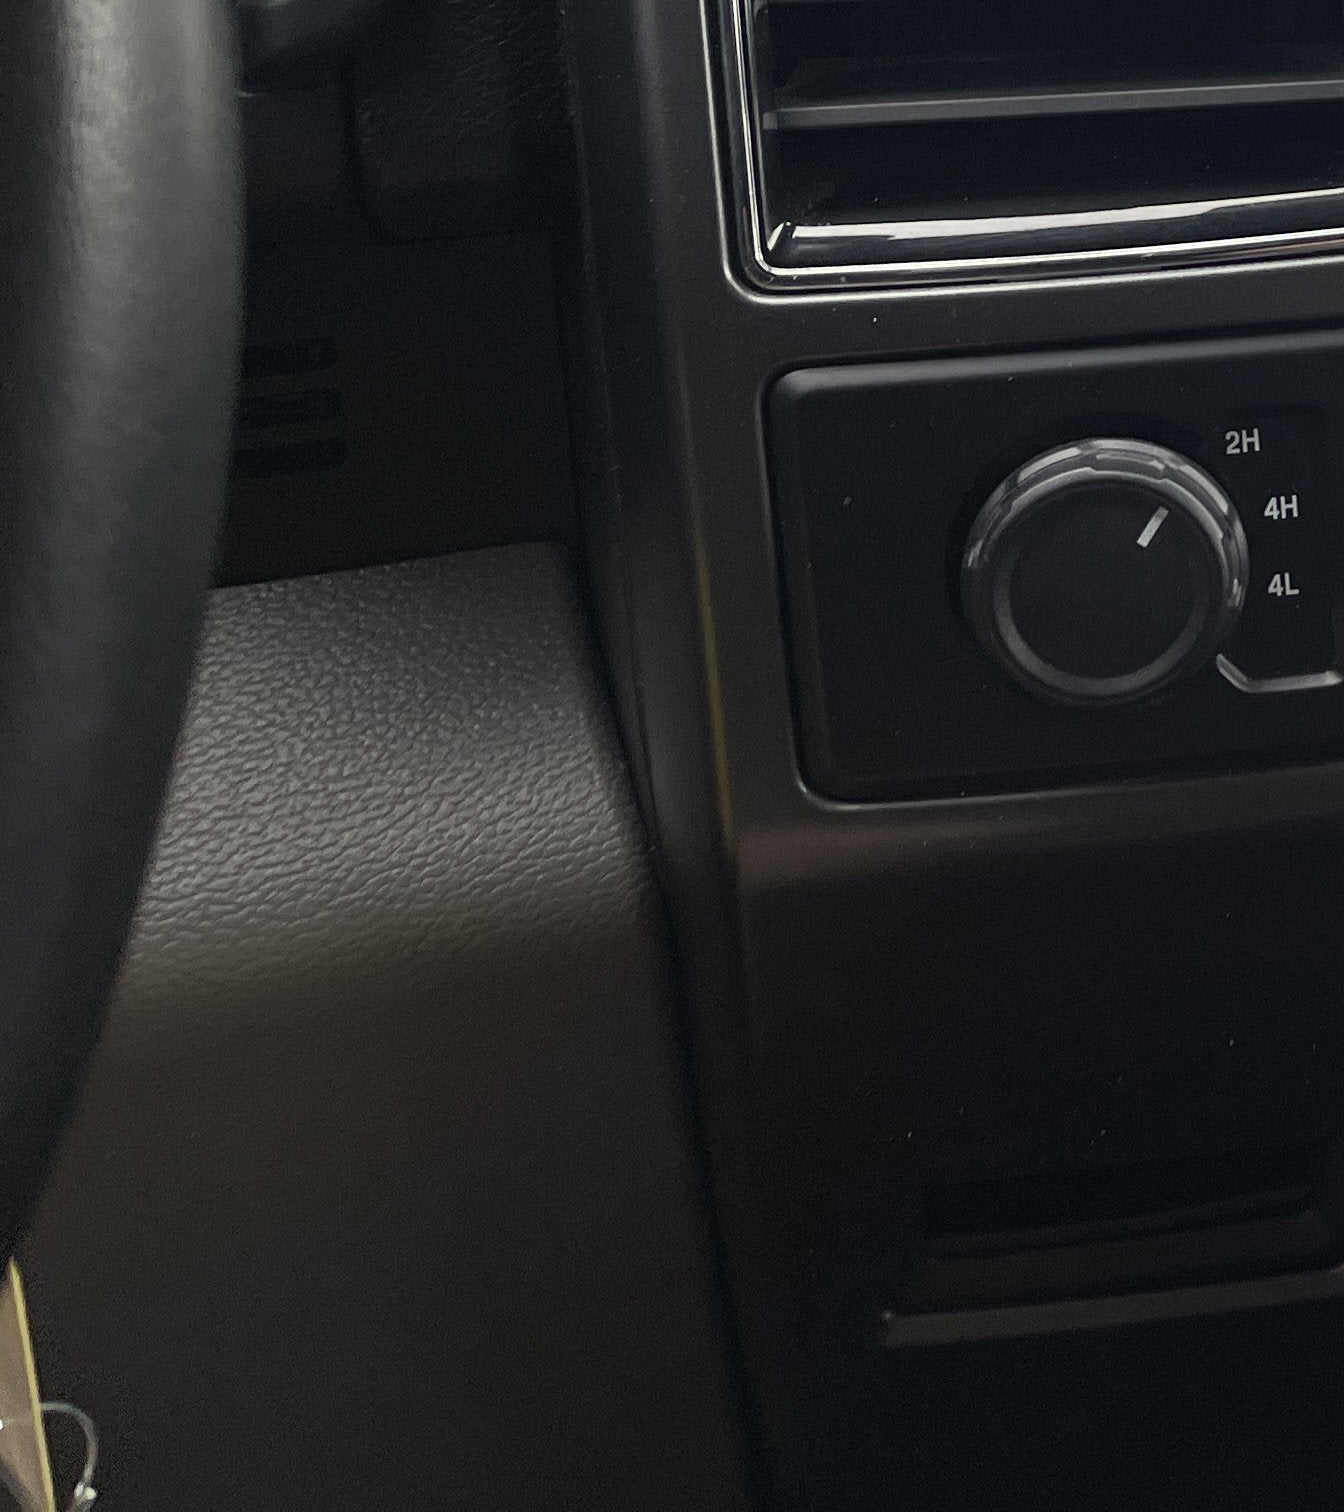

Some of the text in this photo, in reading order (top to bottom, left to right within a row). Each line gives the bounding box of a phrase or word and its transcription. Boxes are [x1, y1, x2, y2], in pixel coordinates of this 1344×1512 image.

[1224, 427, 1261, 455] 2H
[1263, 494, 1299, 520] 4H
[1267, 572, 1299, 597] 4L
